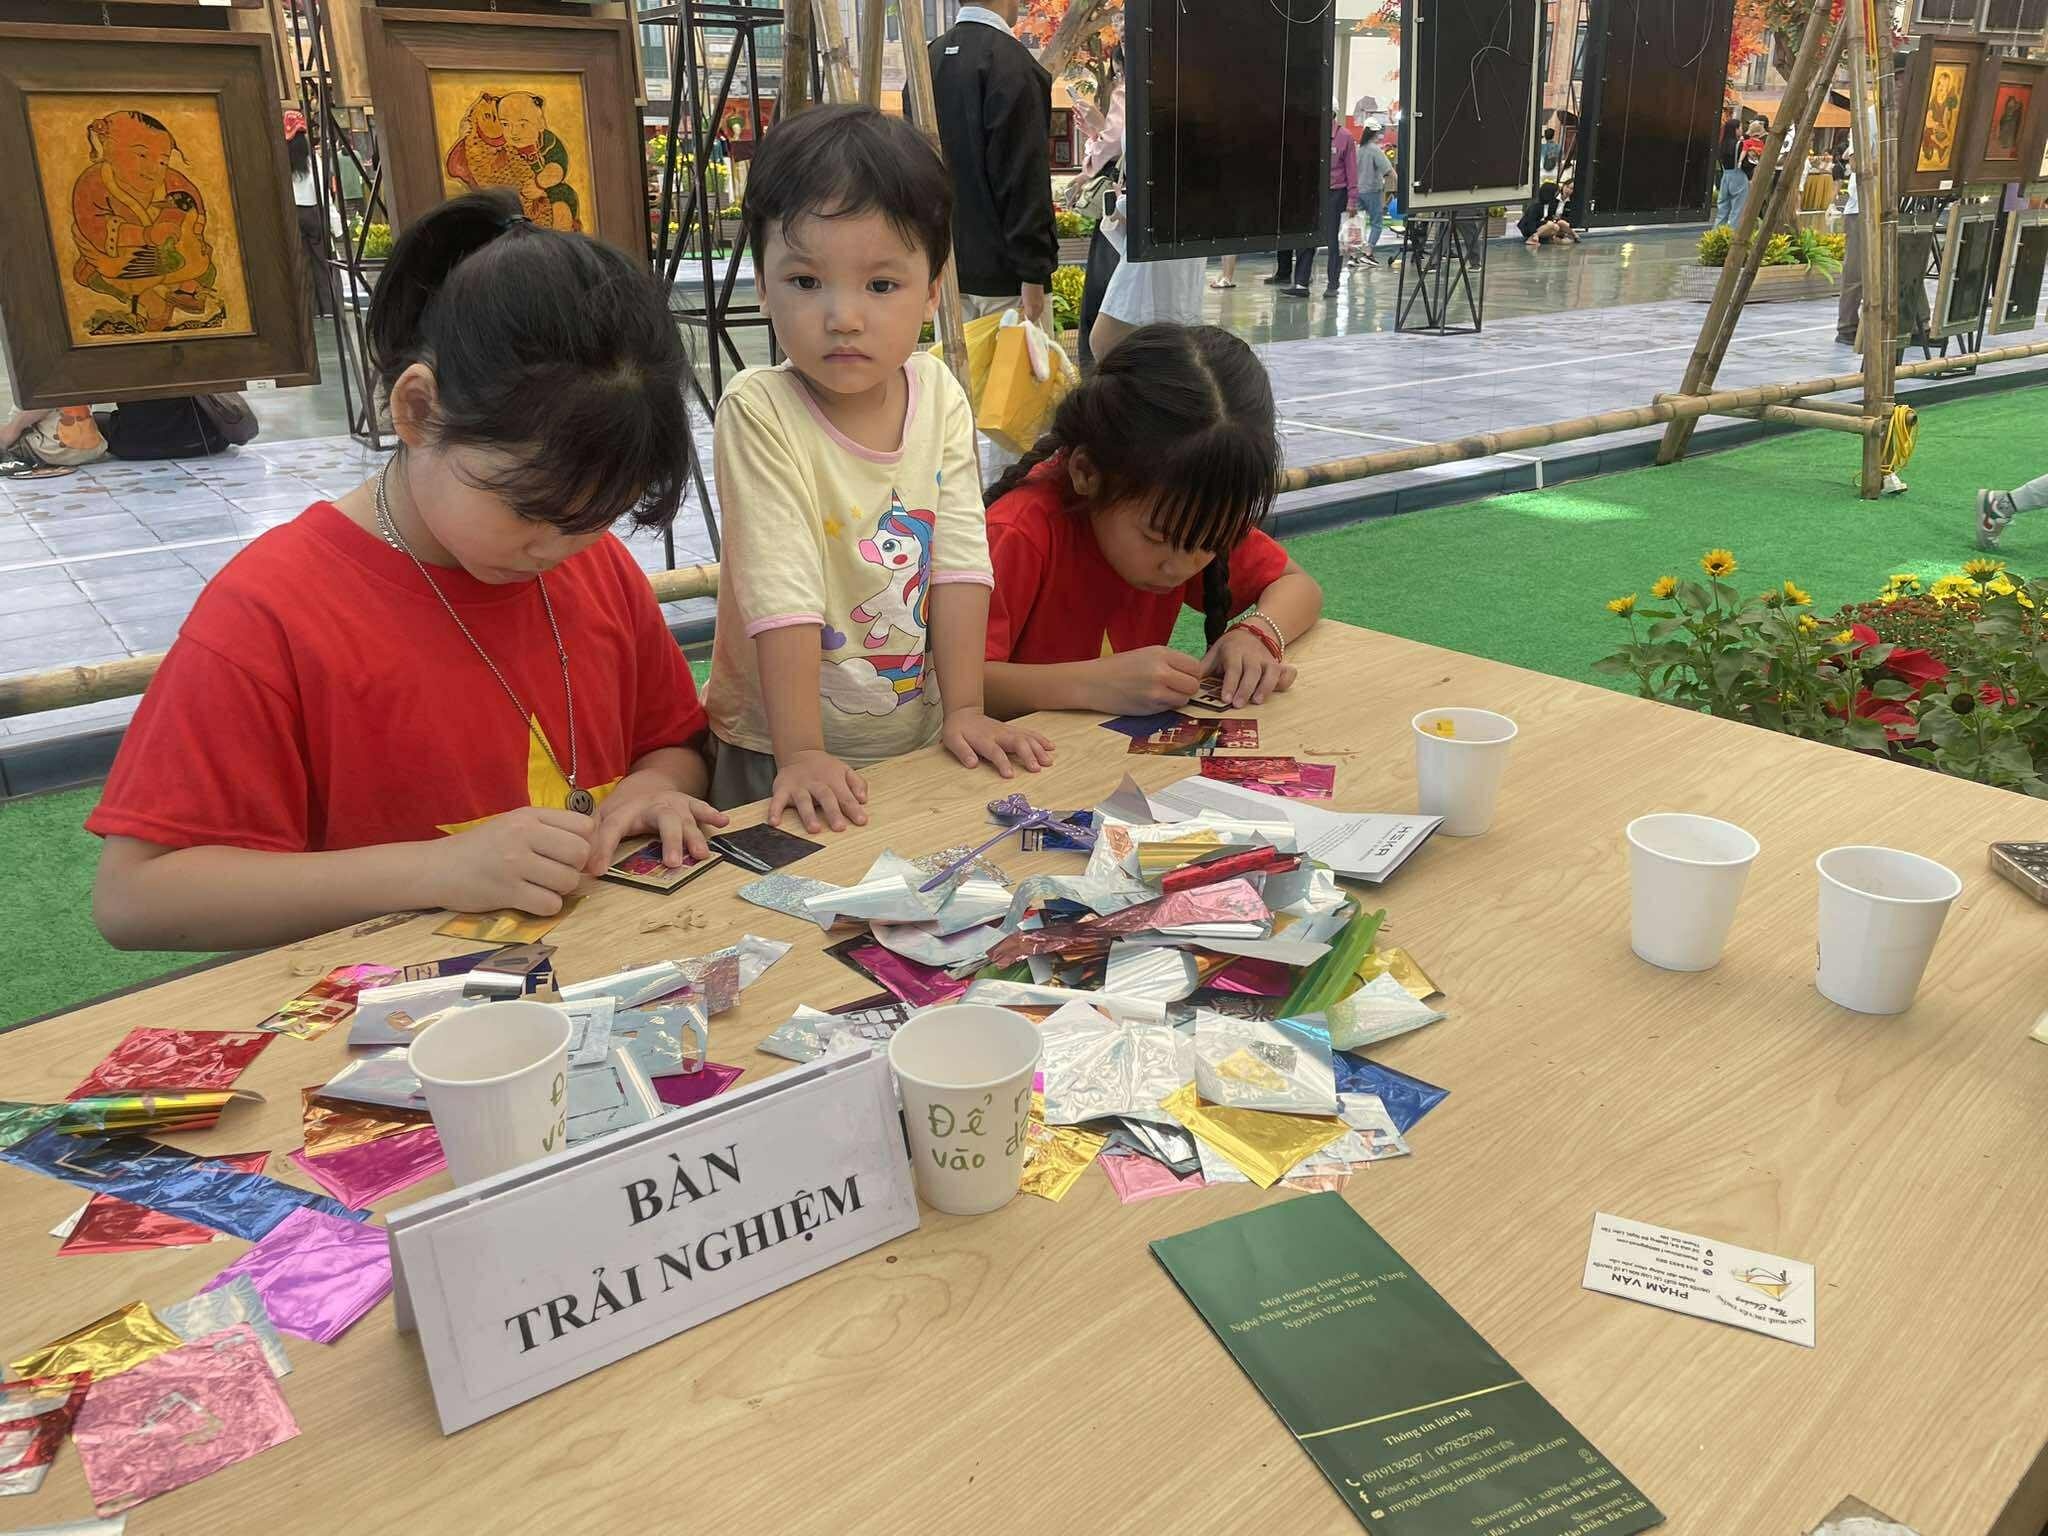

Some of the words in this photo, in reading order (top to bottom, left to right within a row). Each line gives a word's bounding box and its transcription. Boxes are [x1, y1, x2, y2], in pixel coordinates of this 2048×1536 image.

[928, 1093, 992, 1138] Để
[620, 1143, 742, 1227] BÀN
[505, 1264, 647, 1354] TRẢI
[654, 1174, 865, 1293] NGHIỆM
[1282, 1286, 1320, 1303] thương
[1317, 1277, 1342, 1291] hiệu
[1344, 1293, 1377, 1309] Trung
[1646, 1282, 1689, 1300] PHẠM
[1383, 1426, 1422, 1446] Thông
[1419, 1421, 1437, 1434] tin
[1435, 1413, 1457, 1428] liên
[1456, 1408, 1473, 1420] hệ
[1471, 1500, 1527, 1529] Showroom
[1520, 1512, 1539, 1525] Gia
[1598, 1477, 1623, 1492] Ninh
[1570, 1496, 1625, 1523] Showroom
[1621, 1500, 1648, 1514] Ninh
